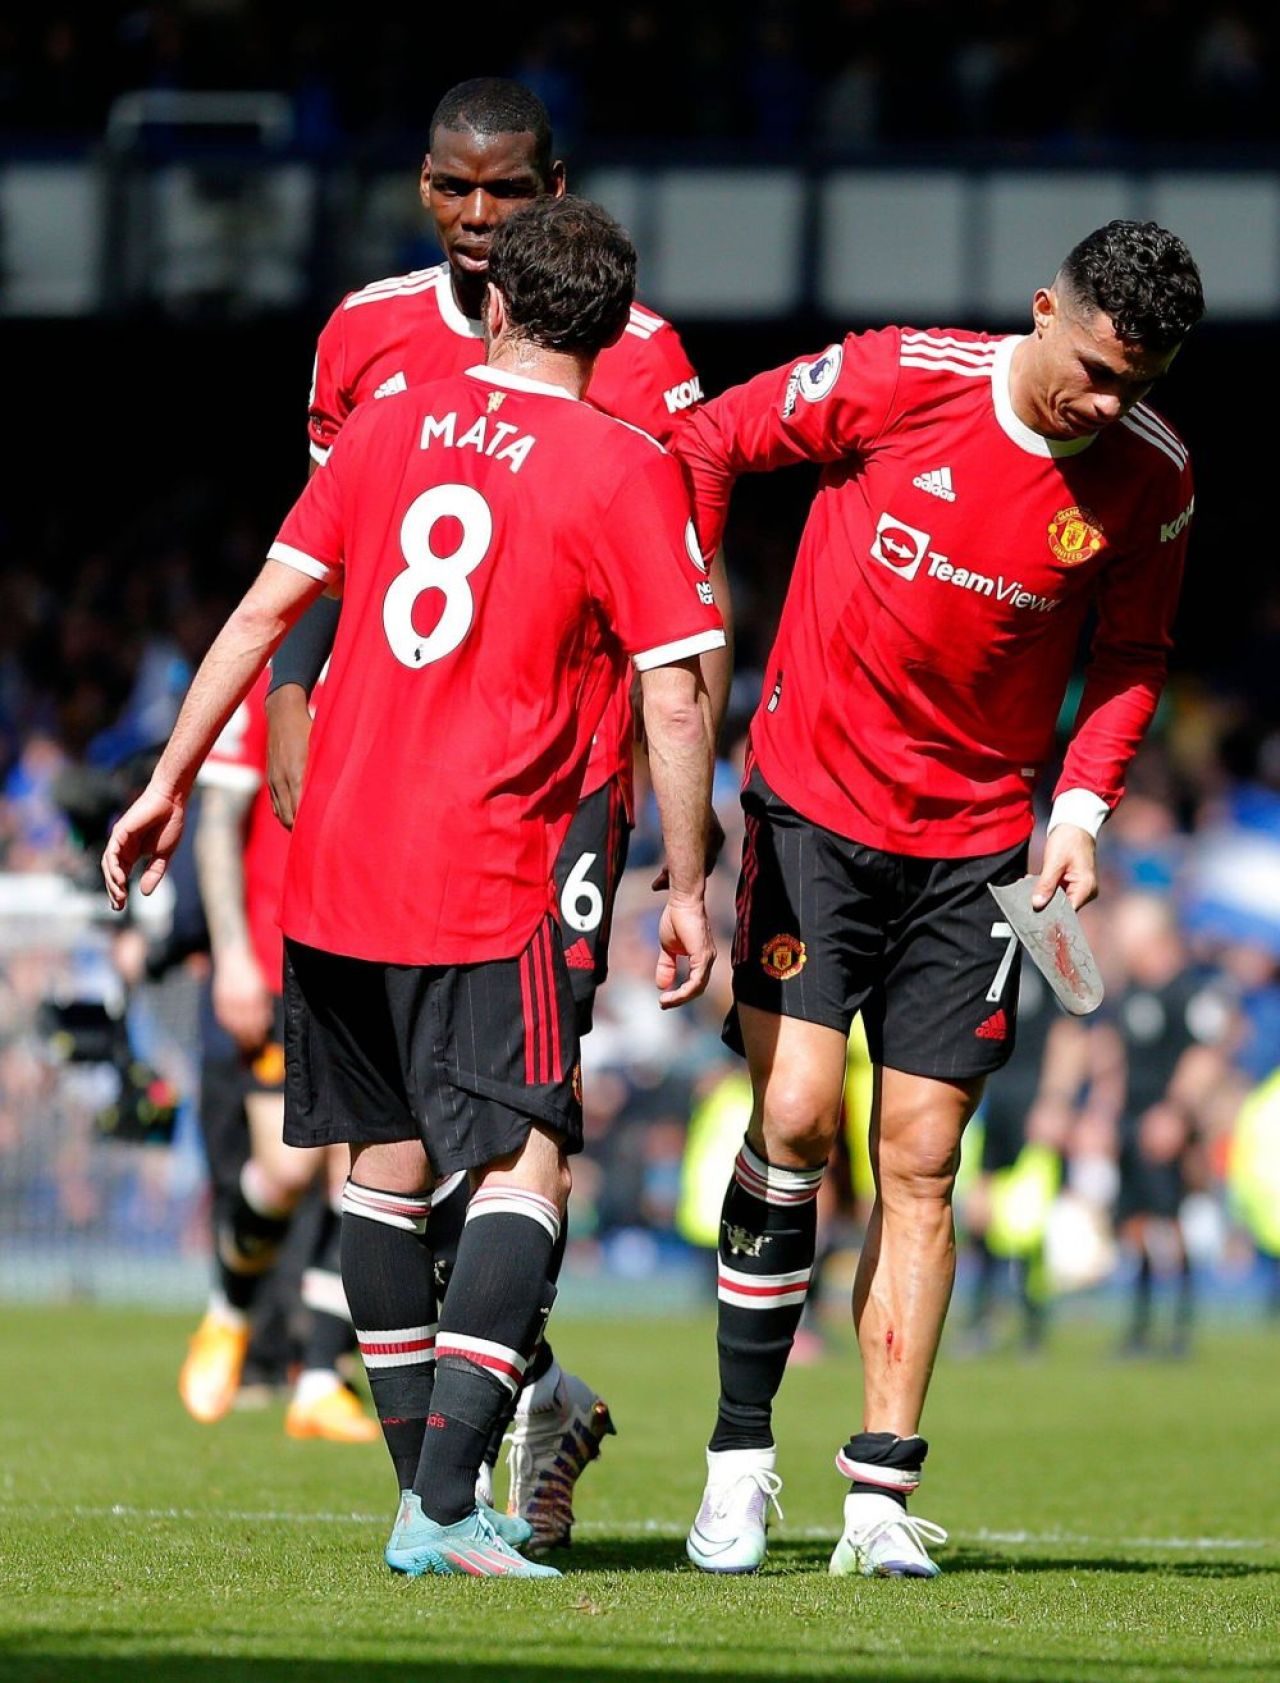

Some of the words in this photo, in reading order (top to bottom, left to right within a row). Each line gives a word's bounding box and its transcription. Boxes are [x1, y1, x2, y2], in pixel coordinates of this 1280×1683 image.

[420, 412, 536, 474] MATA
[912, 476, 956, 502] adidas
[383, 483, 493, 668] 8
[927, 551, 1061, 612] TeamView
[561, 852, 603, 932] 6
[986, 922, 1019, 1002] 7
